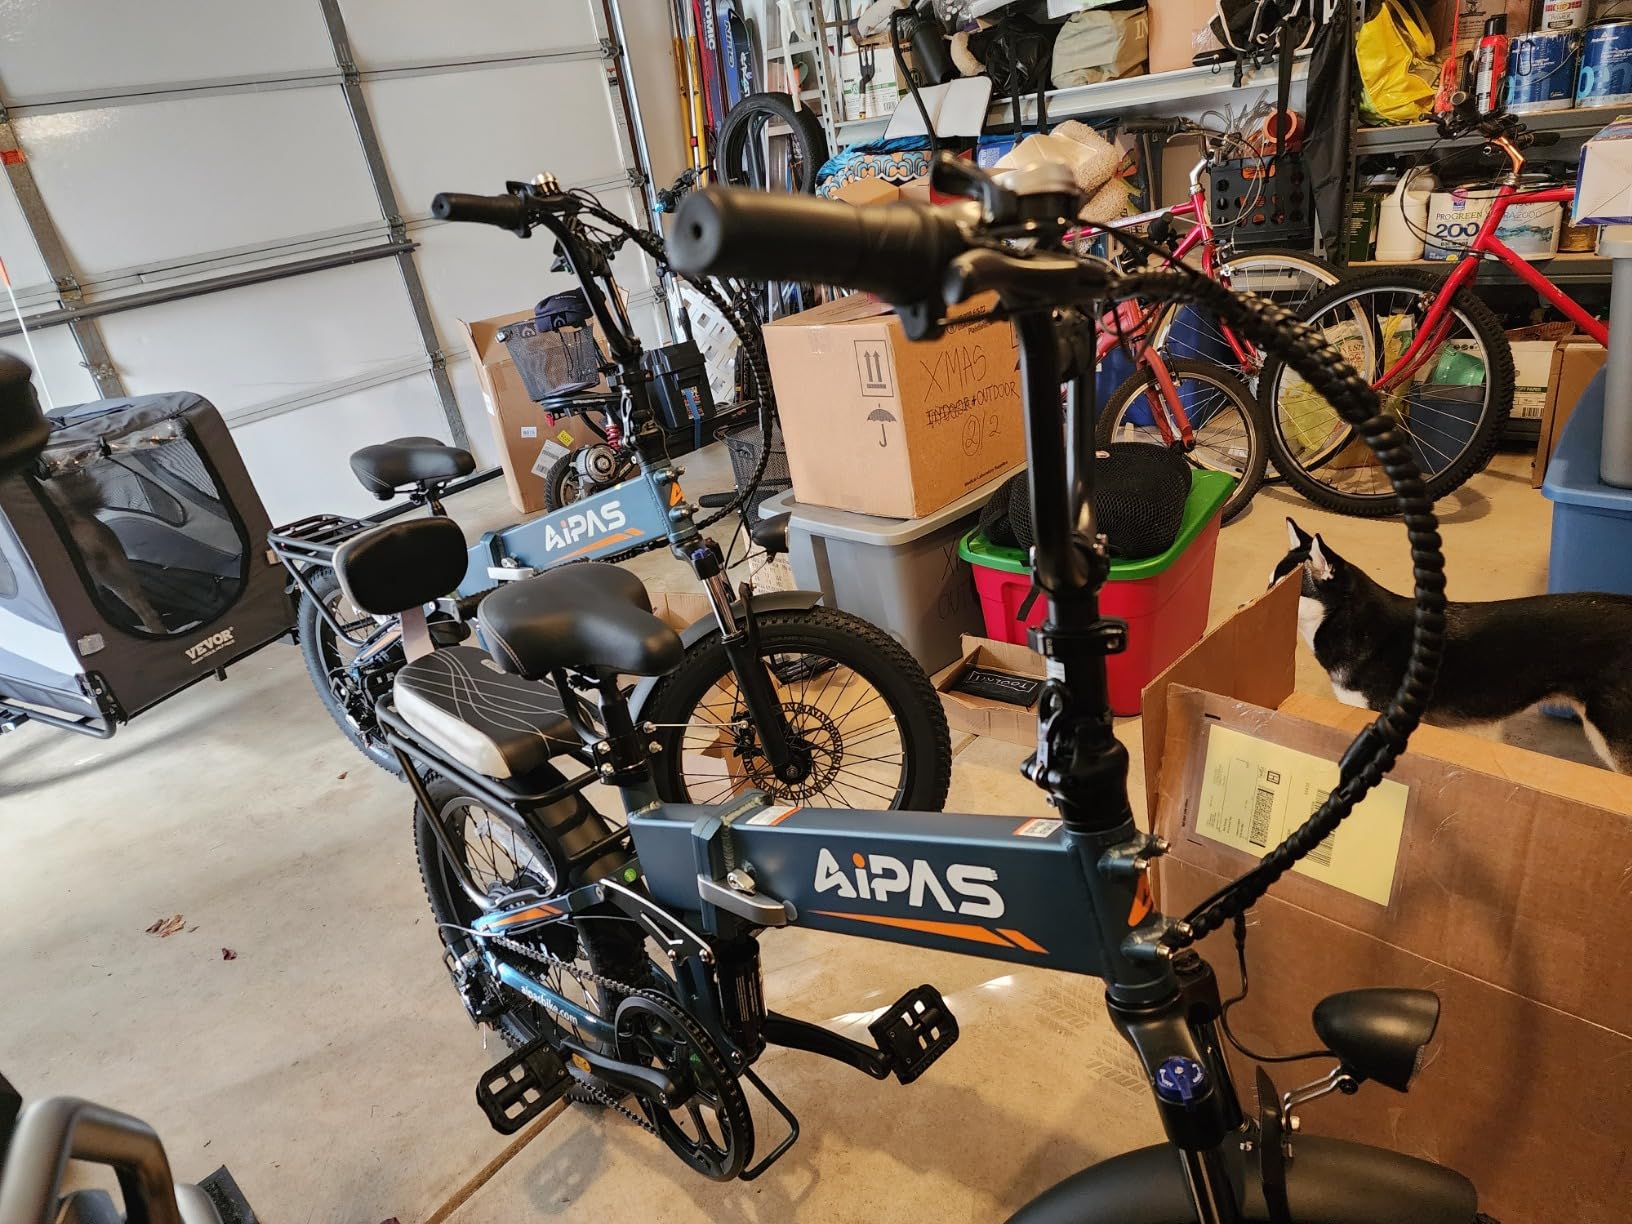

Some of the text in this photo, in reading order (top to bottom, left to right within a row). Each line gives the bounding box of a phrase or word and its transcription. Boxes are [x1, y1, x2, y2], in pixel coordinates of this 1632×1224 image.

[704, 0, 716, 51] TOMIC
[1436, 211, 1482, 221] PROGREEN
[1436, 222, 1480, 238] 200
[919, 345, 987, 403] XMAS
[184, 629, 234, 660] VEVOR
[520, 985, 578, 1026] aipasbike.com
